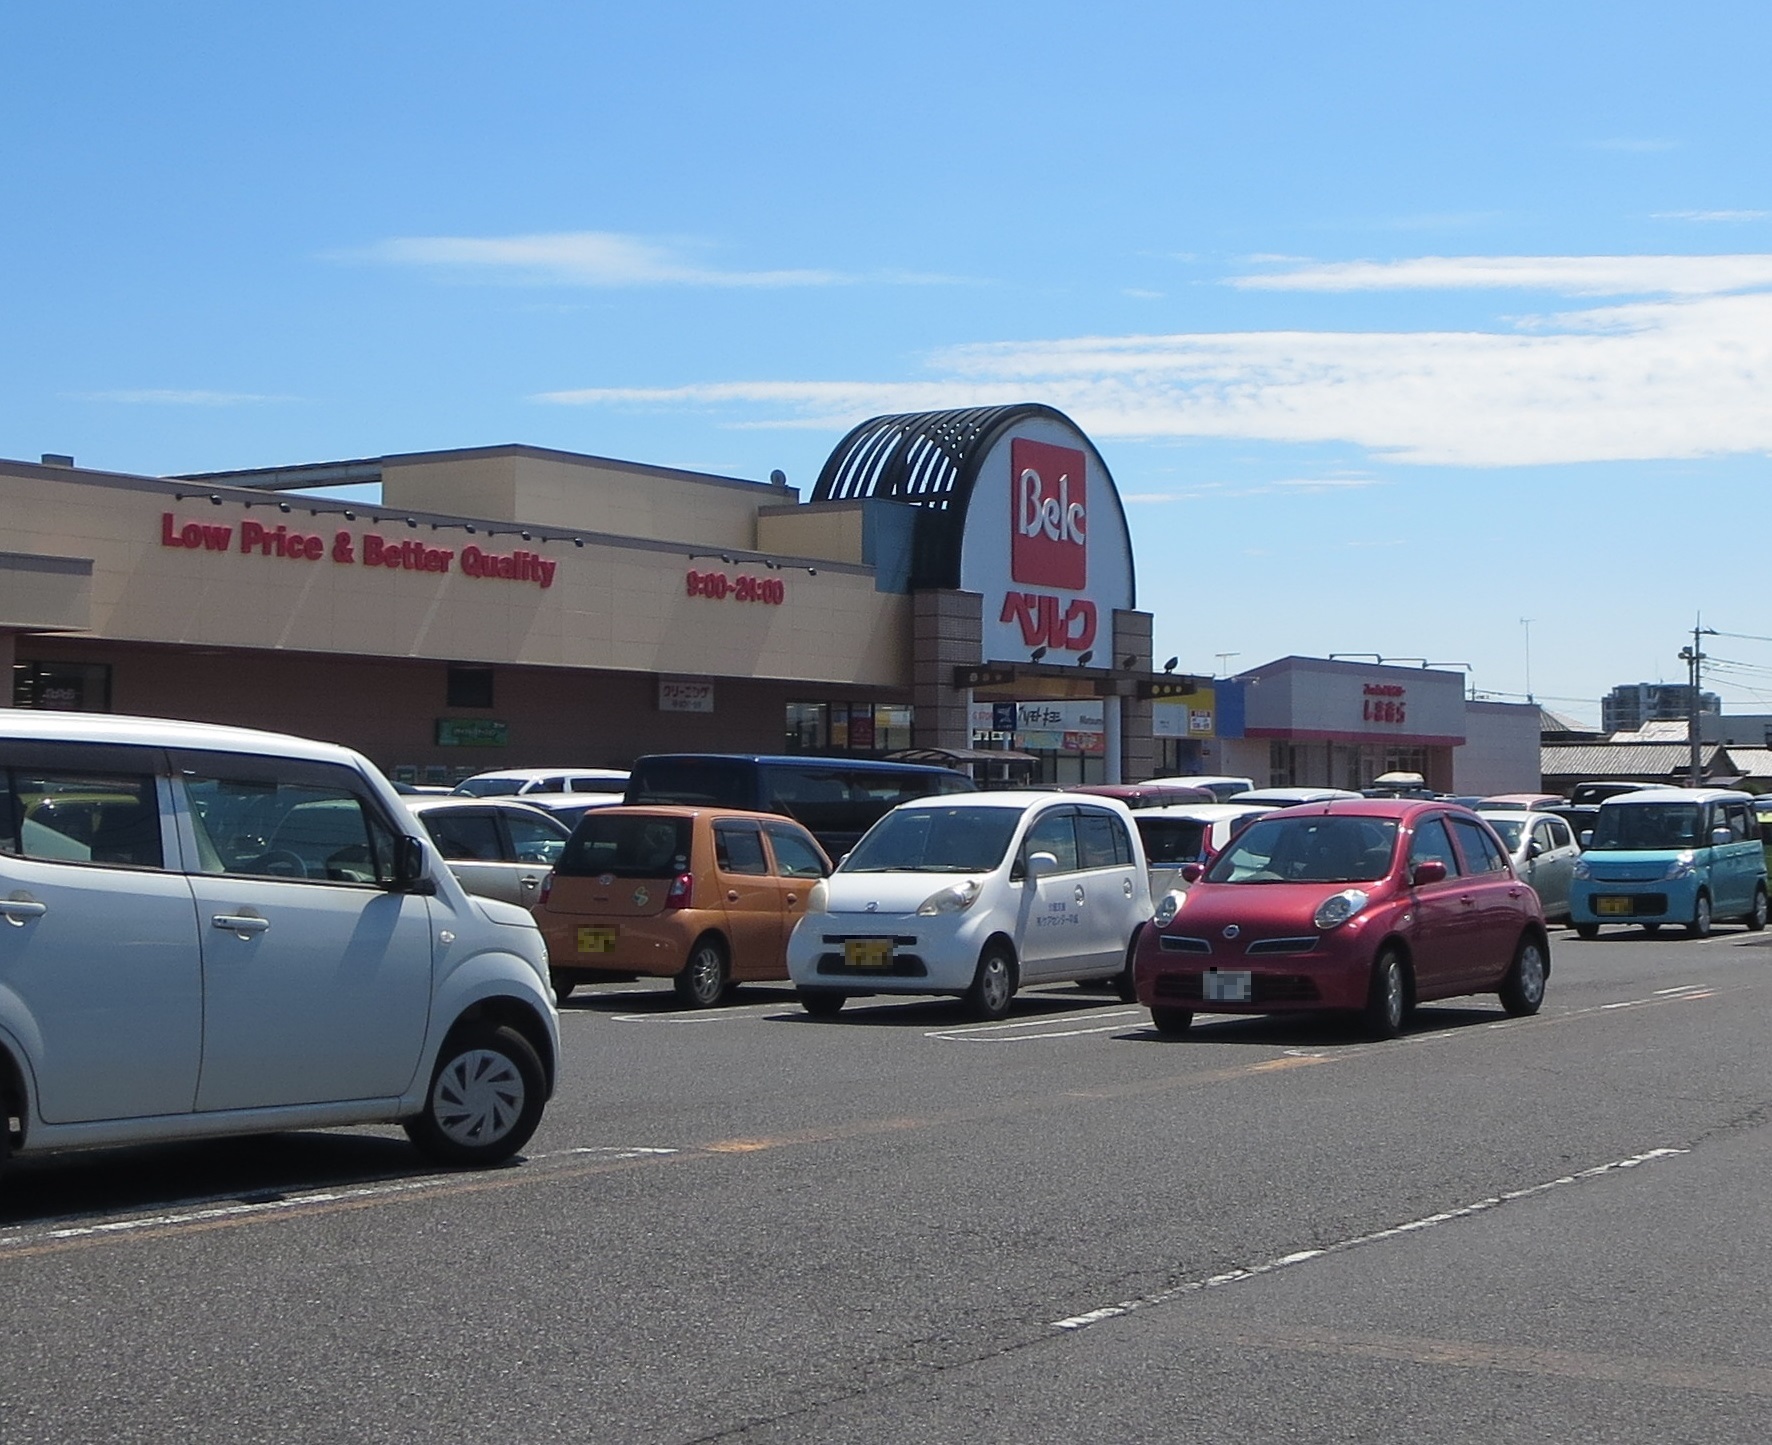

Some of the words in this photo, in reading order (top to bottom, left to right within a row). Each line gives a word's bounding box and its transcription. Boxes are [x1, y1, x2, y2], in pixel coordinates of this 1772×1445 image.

[1019, 467, 1085, 545] Belc
[162, 512, 232, 551] Low
[240, 520, 323, 561] Price
[331, 530, 355, 563] &
[362, 533, 454, 573] Better
[460, 544, 556, 589] Quality
[999, 591, 1096, 650] ベルク
